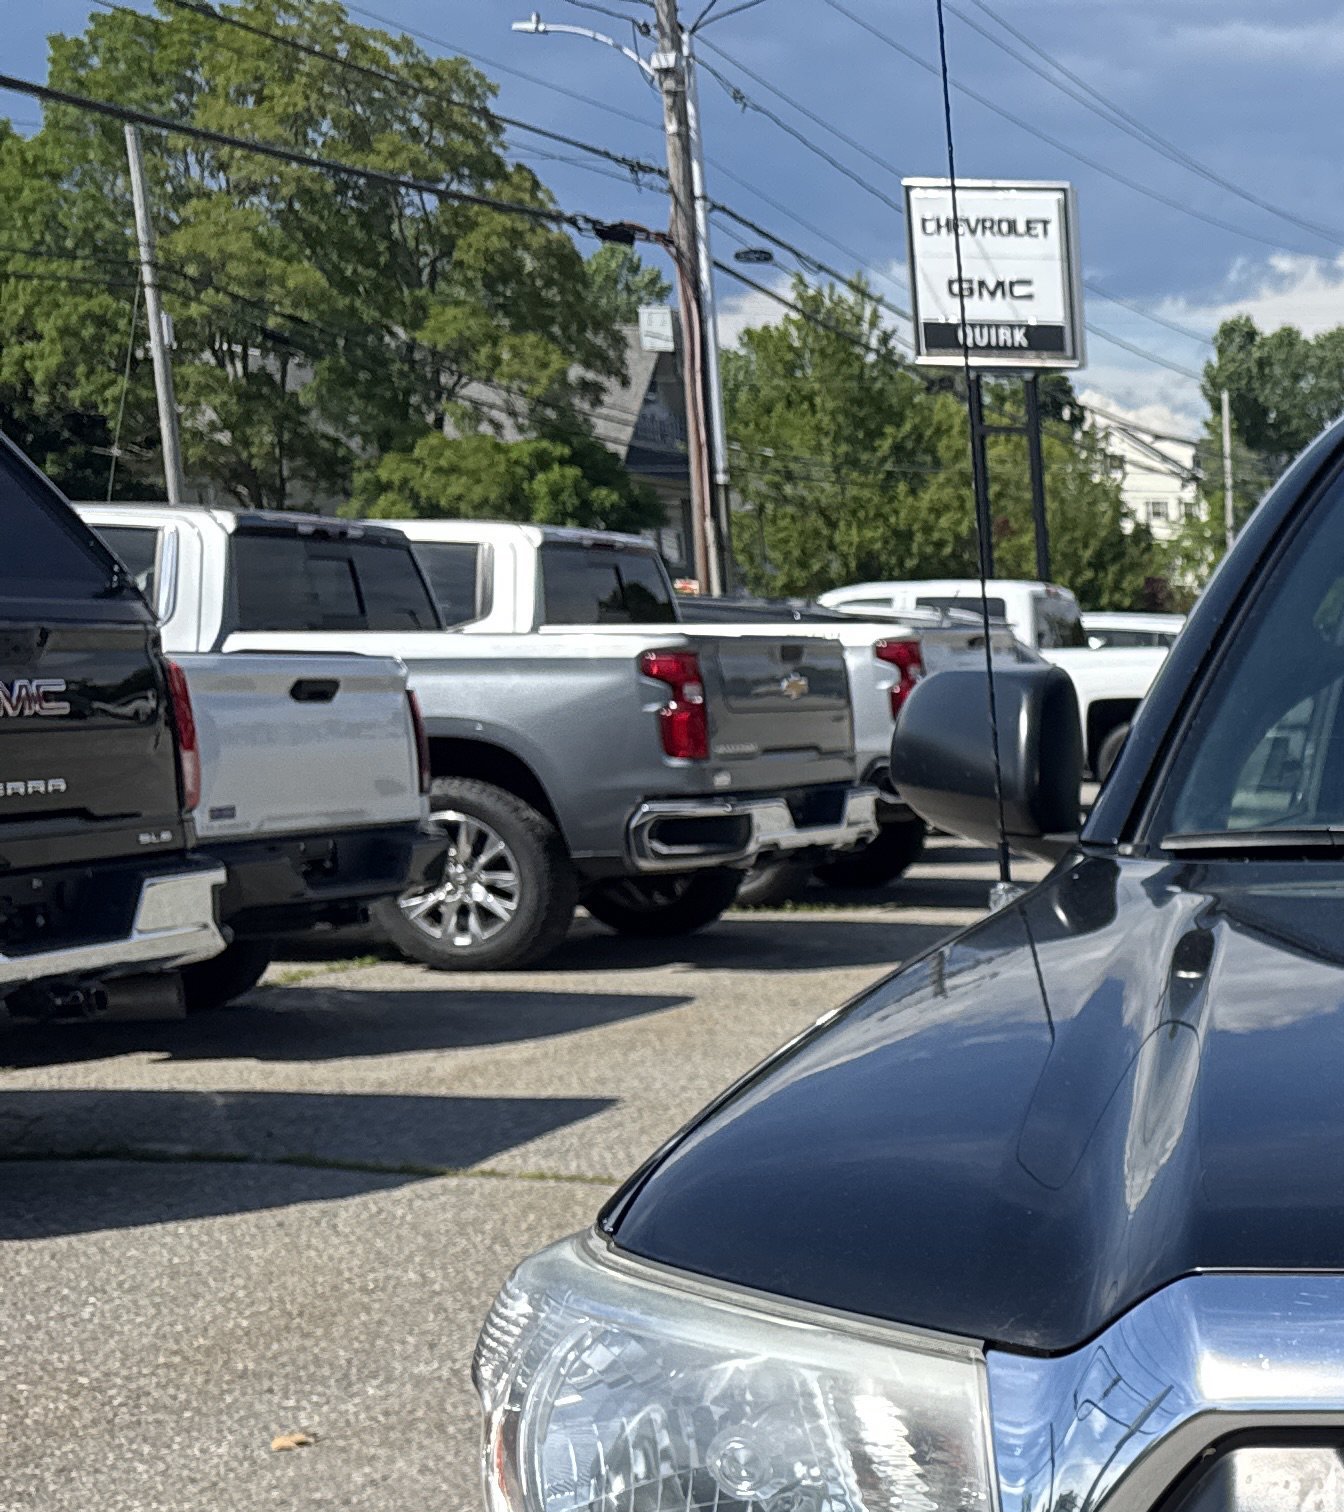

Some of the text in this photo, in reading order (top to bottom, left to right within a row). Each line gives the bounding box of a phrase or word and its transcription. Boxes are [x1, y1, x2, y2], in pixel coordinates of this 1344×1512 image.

[920, 216, 1051, 239] CHEVROLET
[948, 278, 1034, 301] GMC
[957, 324, 1029, 348] QUIRK
[0, 778, 67, 797] RRA
